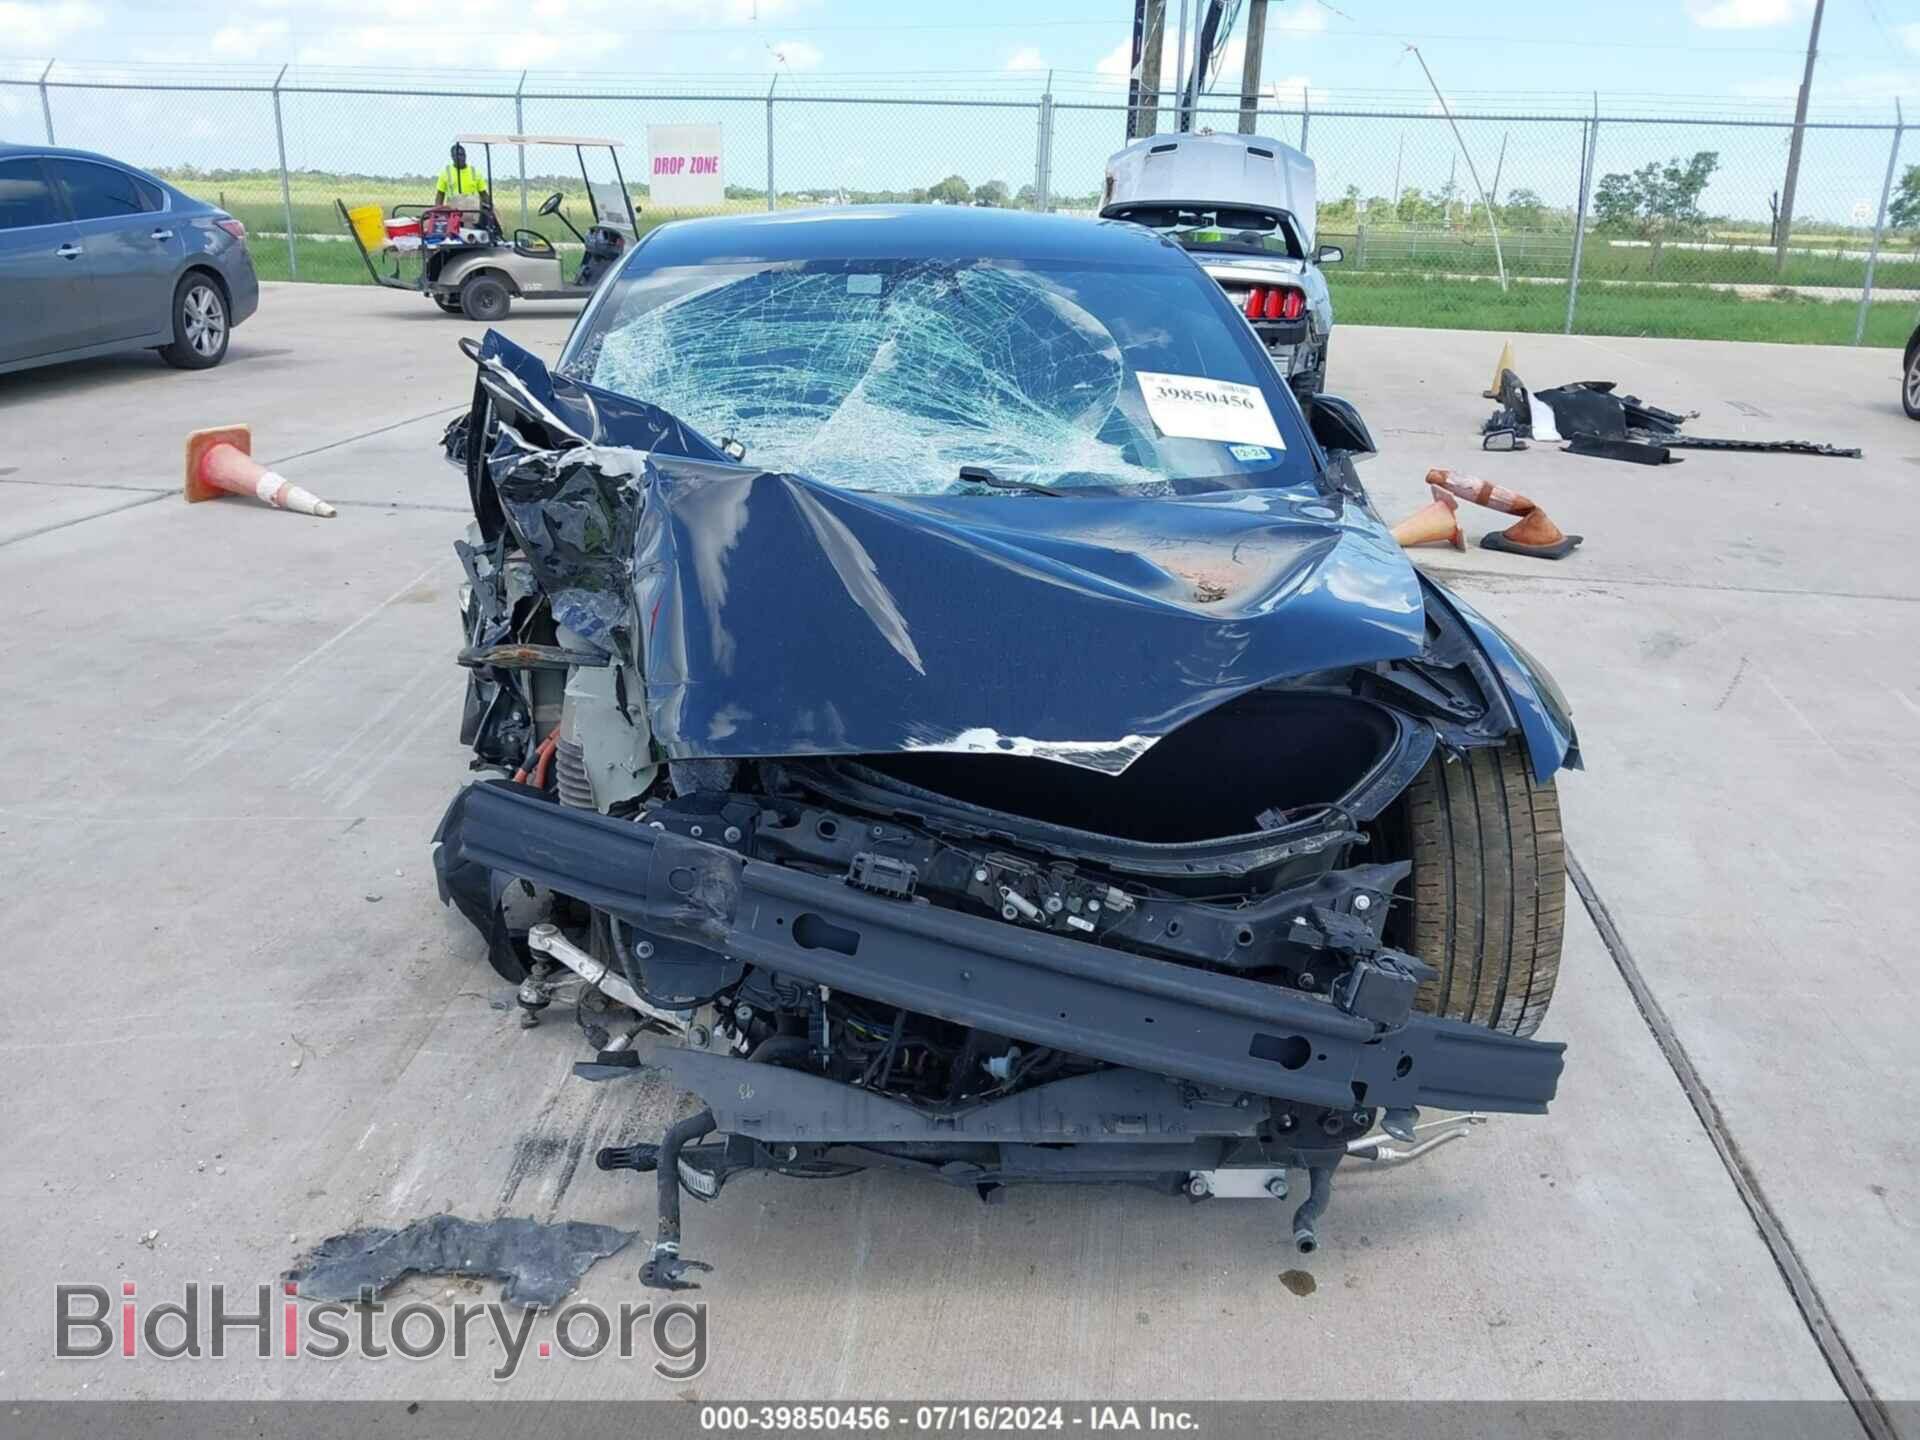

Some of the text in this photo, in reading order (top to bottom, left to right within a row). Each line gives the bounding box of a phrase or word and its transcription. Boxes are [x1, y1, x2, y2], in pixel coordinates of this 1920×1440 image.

[653, 155, 719, 175] DROP ZONE
[1155, 385, 1255, 410] 39850456
